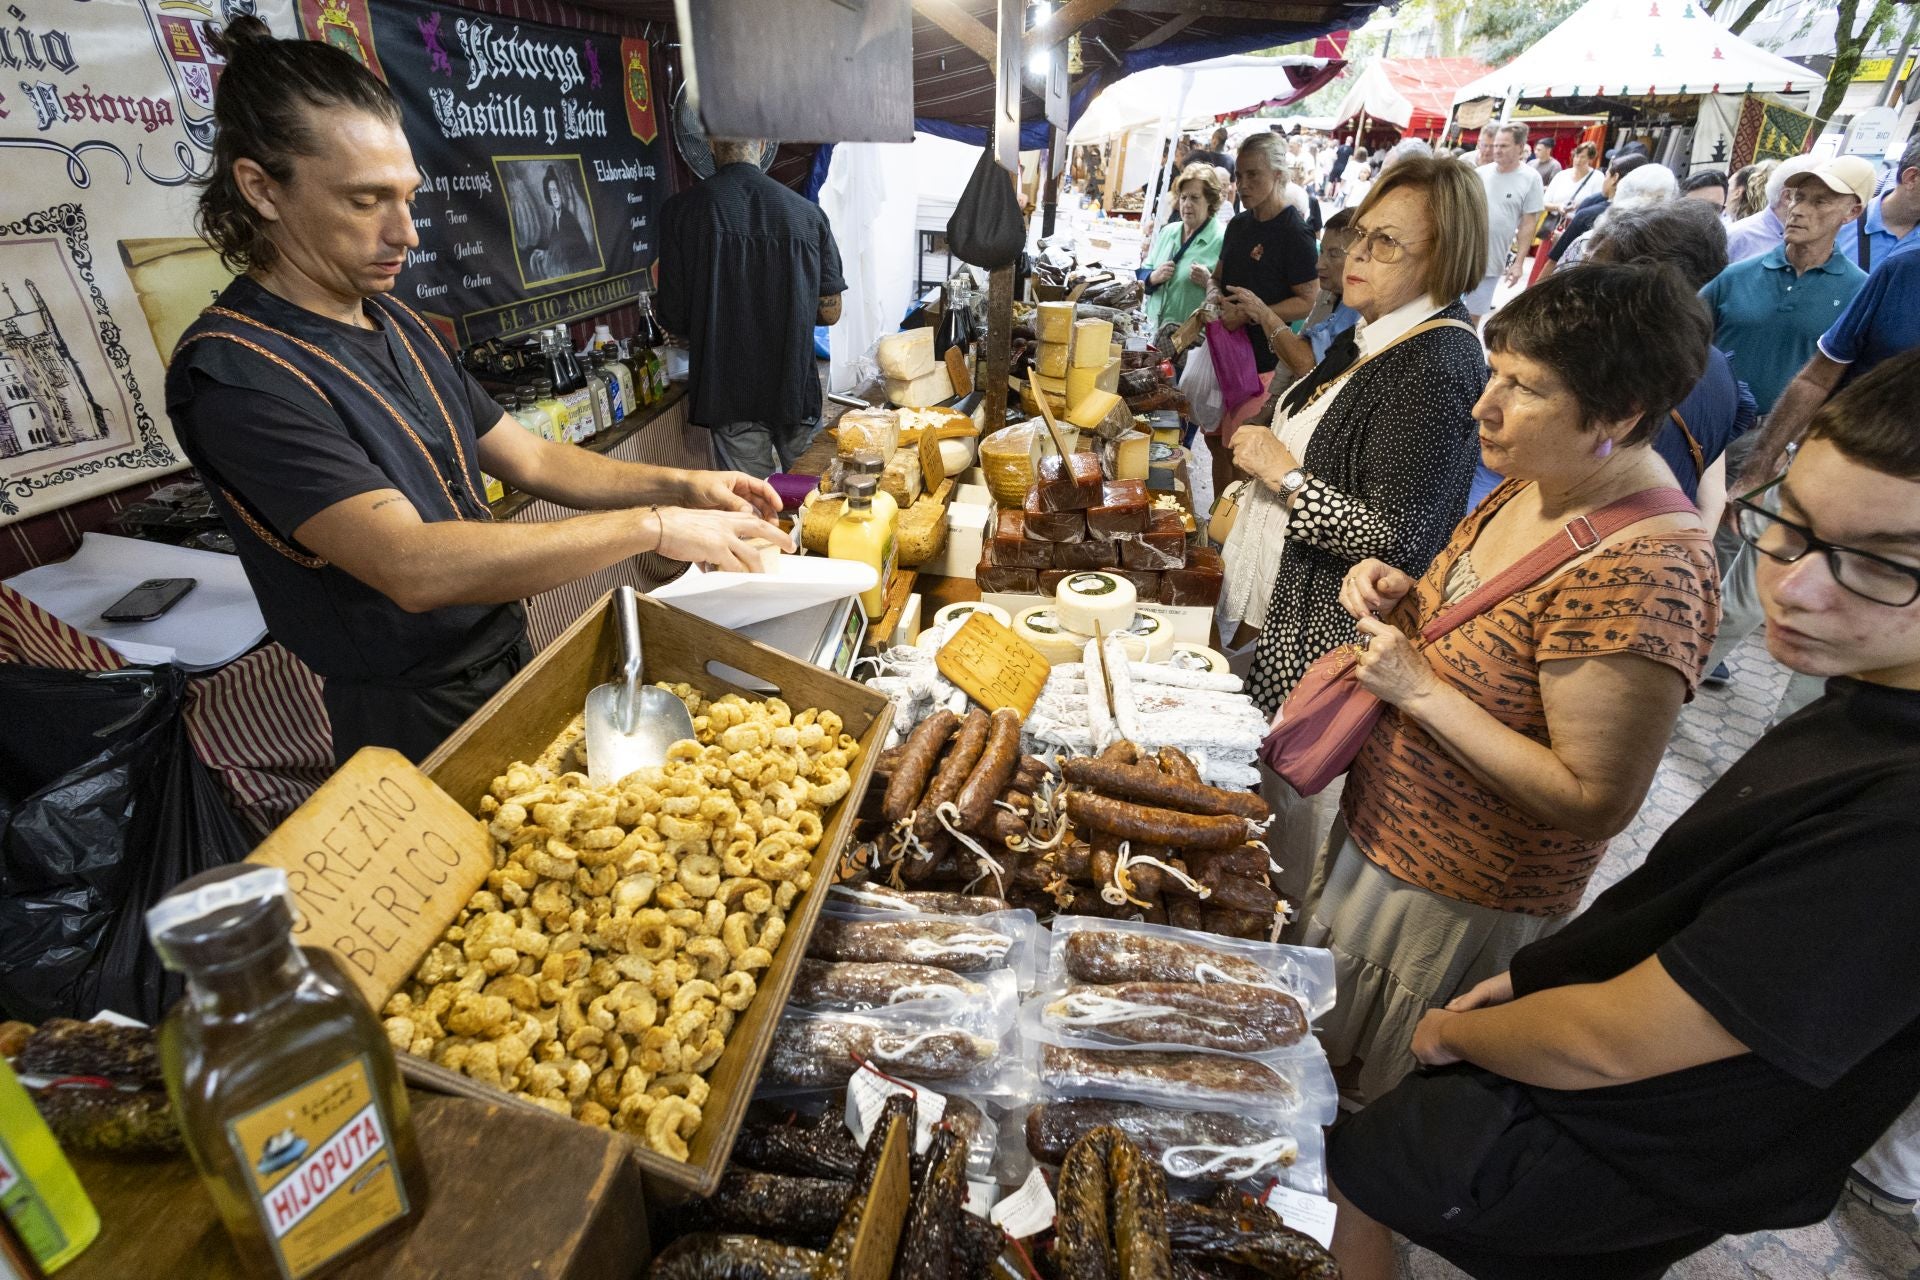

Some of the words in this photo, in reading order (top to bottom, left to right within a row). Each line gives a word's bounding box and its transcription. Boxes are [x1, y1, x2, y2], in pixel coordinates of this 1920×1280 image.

[455, 17, 585, 94] Astorga
[19, 80, 175, 133] Astorga
[428, 87, 537, 138] Castilla
[542, 104, 558, 145] y
[561, 97, 608, 140] León
[435, 175, 450, 200] en
[452, 164, 492, 200] cecinas
[593, 159, 637, 181] Elaborados
[445, 209, 468, 225] Toro
[407, 249, 437, 268] Potro
[416, 283, 448, 299] Ciervo
[463, 273, 492, 290] Cabra
[499, 308, 524, 332] EL
[529, 297, 561, 323] TIO
[566, 279, 632, 312] ANTONIO
[991, 658, 1027, 697] PIEZAS
[286, 777, 417, 934] RREZNO
[273, 1116, 380, 1227] HIJOPUTA
